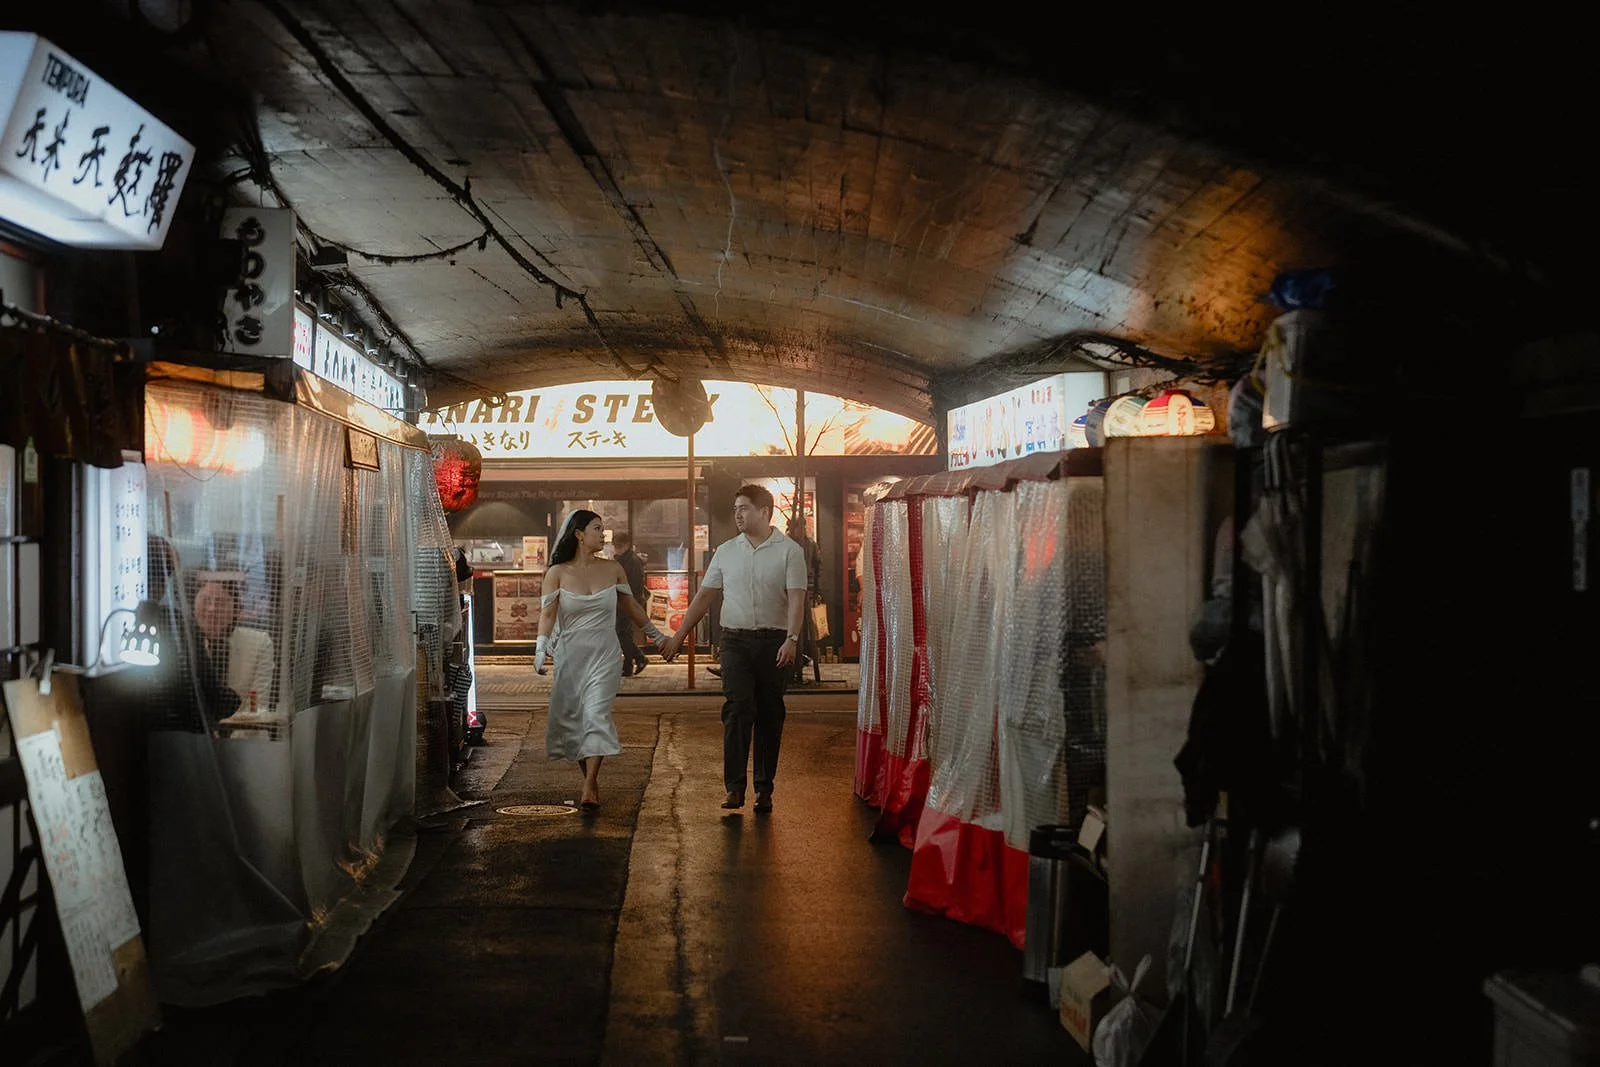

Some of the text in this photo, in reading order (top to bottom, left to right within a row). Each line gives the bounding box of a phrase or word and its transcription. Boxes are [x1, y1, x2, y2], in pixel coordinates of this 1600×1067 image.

[572, 394, 720, 424] STE
[568, 430, 627, 449] ステーキ
